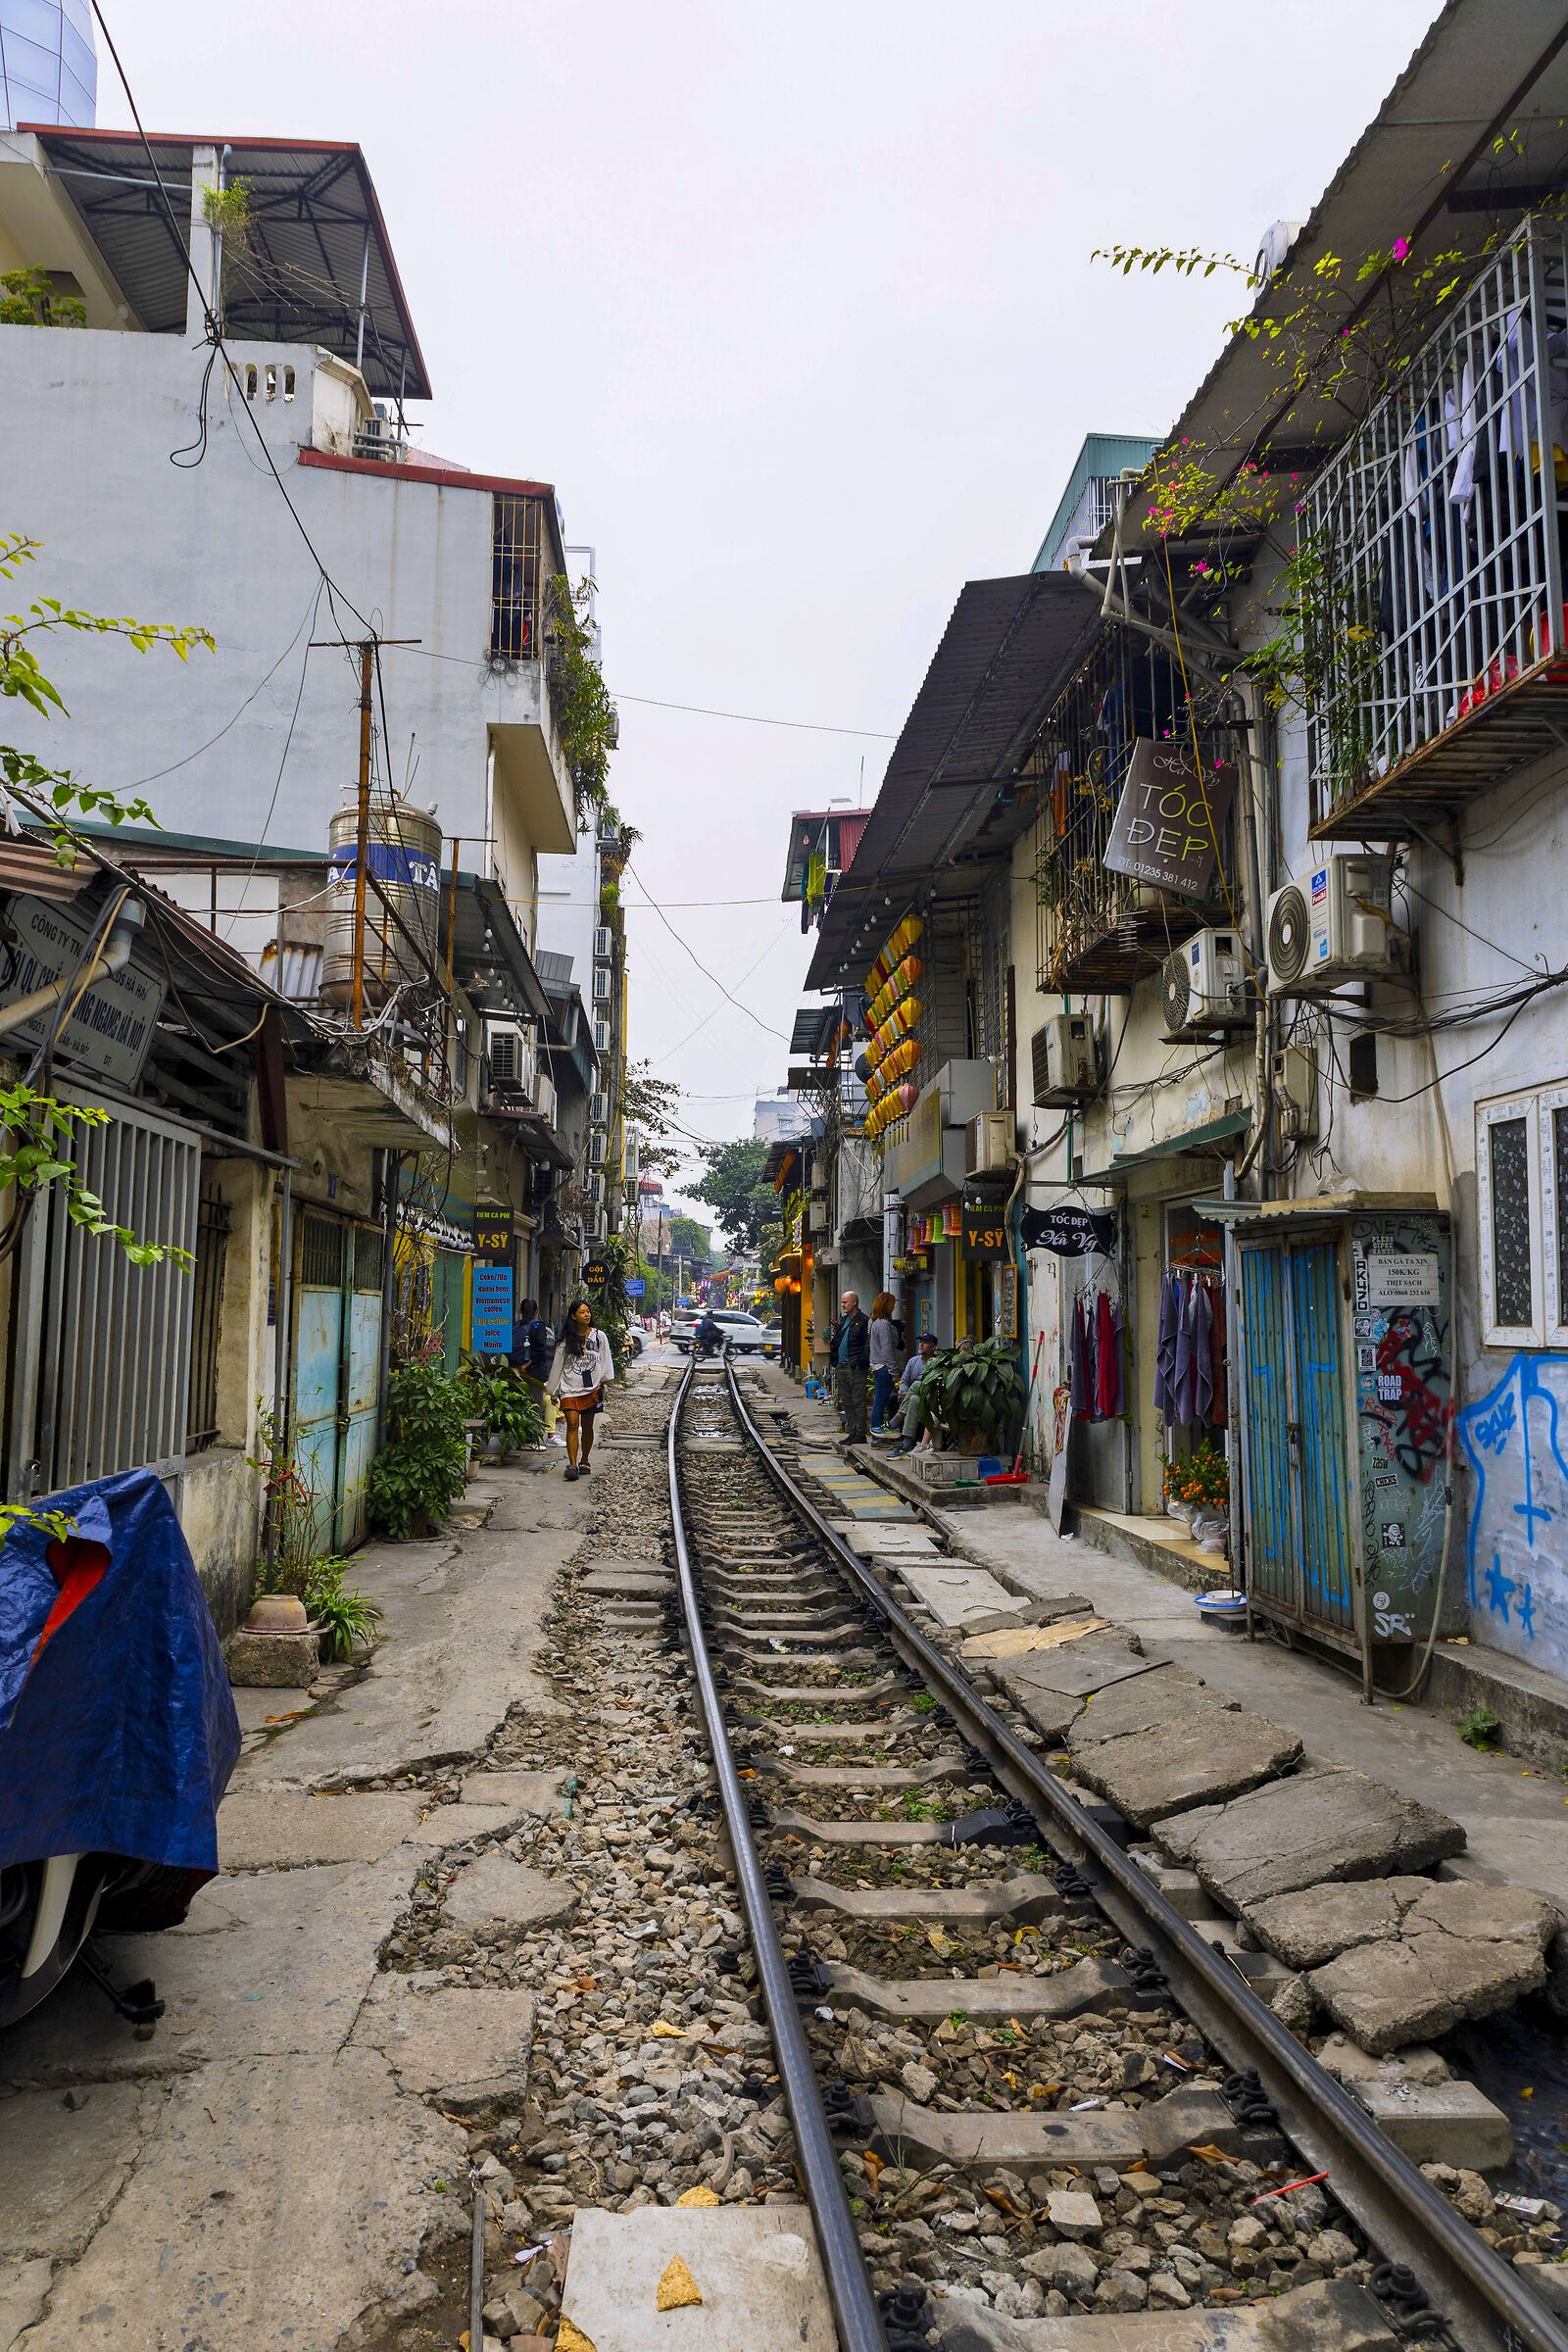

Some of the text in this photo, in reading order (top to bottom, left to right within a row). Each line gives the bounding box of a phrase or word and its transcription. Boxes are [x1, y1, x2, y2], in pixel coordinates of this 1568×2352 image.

[1140, 783, 1213, 827] TÓC
[1126, 817, 1209, 864] ĐẸP
[1133, 861, 1161, 880] 01235
[1162, 871, 1178, 885] 381
[1180, 875, 1199, 891] 412
[30, 913, 58, 942] CÔNG
[57, 930, 71, 949] TY
[1050, 1212, 1089, 1228] TÓC ĐẸP
[477, 1231, 509, 1249] Y-SỸ
[968, 1227, 1004, 1248] Y-SỸ
[1378, 1256, 1393, 1265] BÁN
[1393, 1256, 1404, 1265] GÀ
[475, 1317, 488, 1326] Egg
[1378, 1375, 1402, 1387] ROAD
[1378, 1389, 1402, 1400] TRAP
